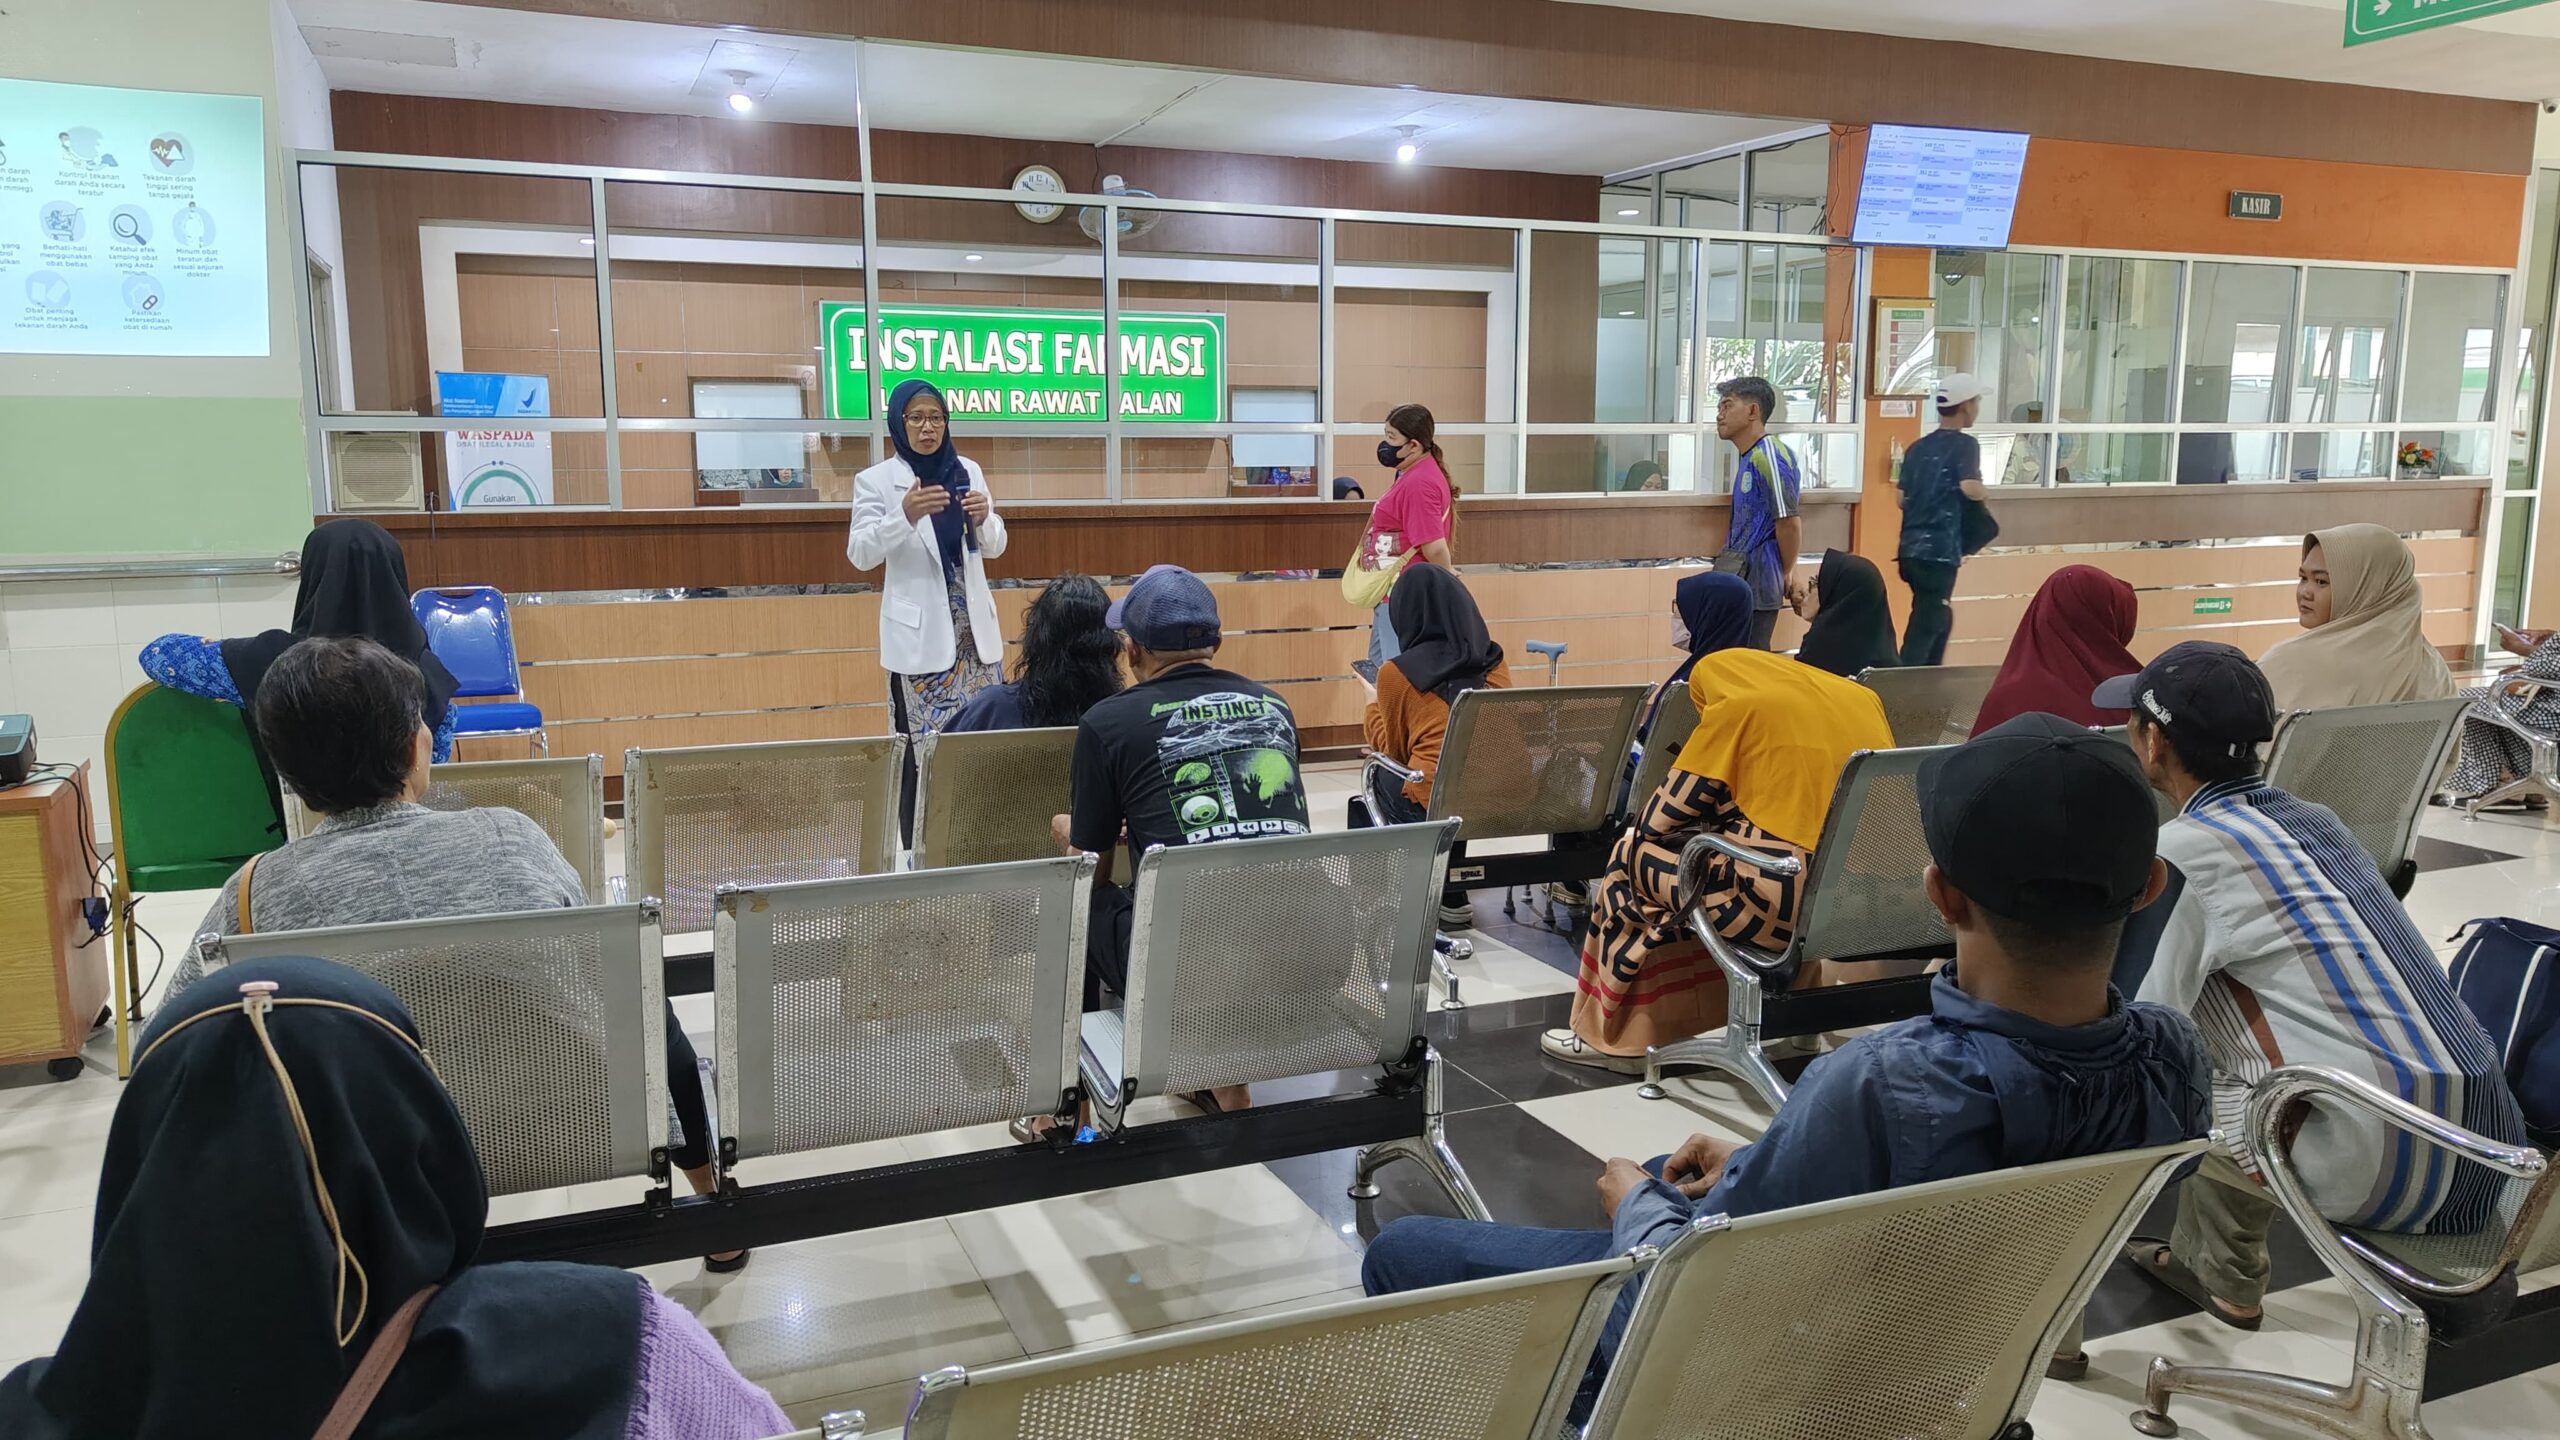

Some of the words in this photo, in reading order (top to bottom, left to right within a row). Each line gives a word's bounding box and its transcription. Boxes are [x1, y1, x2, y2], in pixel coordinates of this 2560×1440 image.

[58, 170, 87, 179] Kontrol
[89, 172, 120, 180] tekanan
[143, 173, 171, 182] Tekanan
[173, 175, 196, 183] darah
[79, 180, 99, 188] Anda
[2241, 197, 2271, 215] KASIR
[848, 328, 1044, 374] INSTALASI
[1009, 390, 1101, 415] RAWAT
[1119, 390, 1183, 415] ALAN
[483, 494, 516, 504] Gunakan
[1181, 701, 1266, 721] INSTINCT
